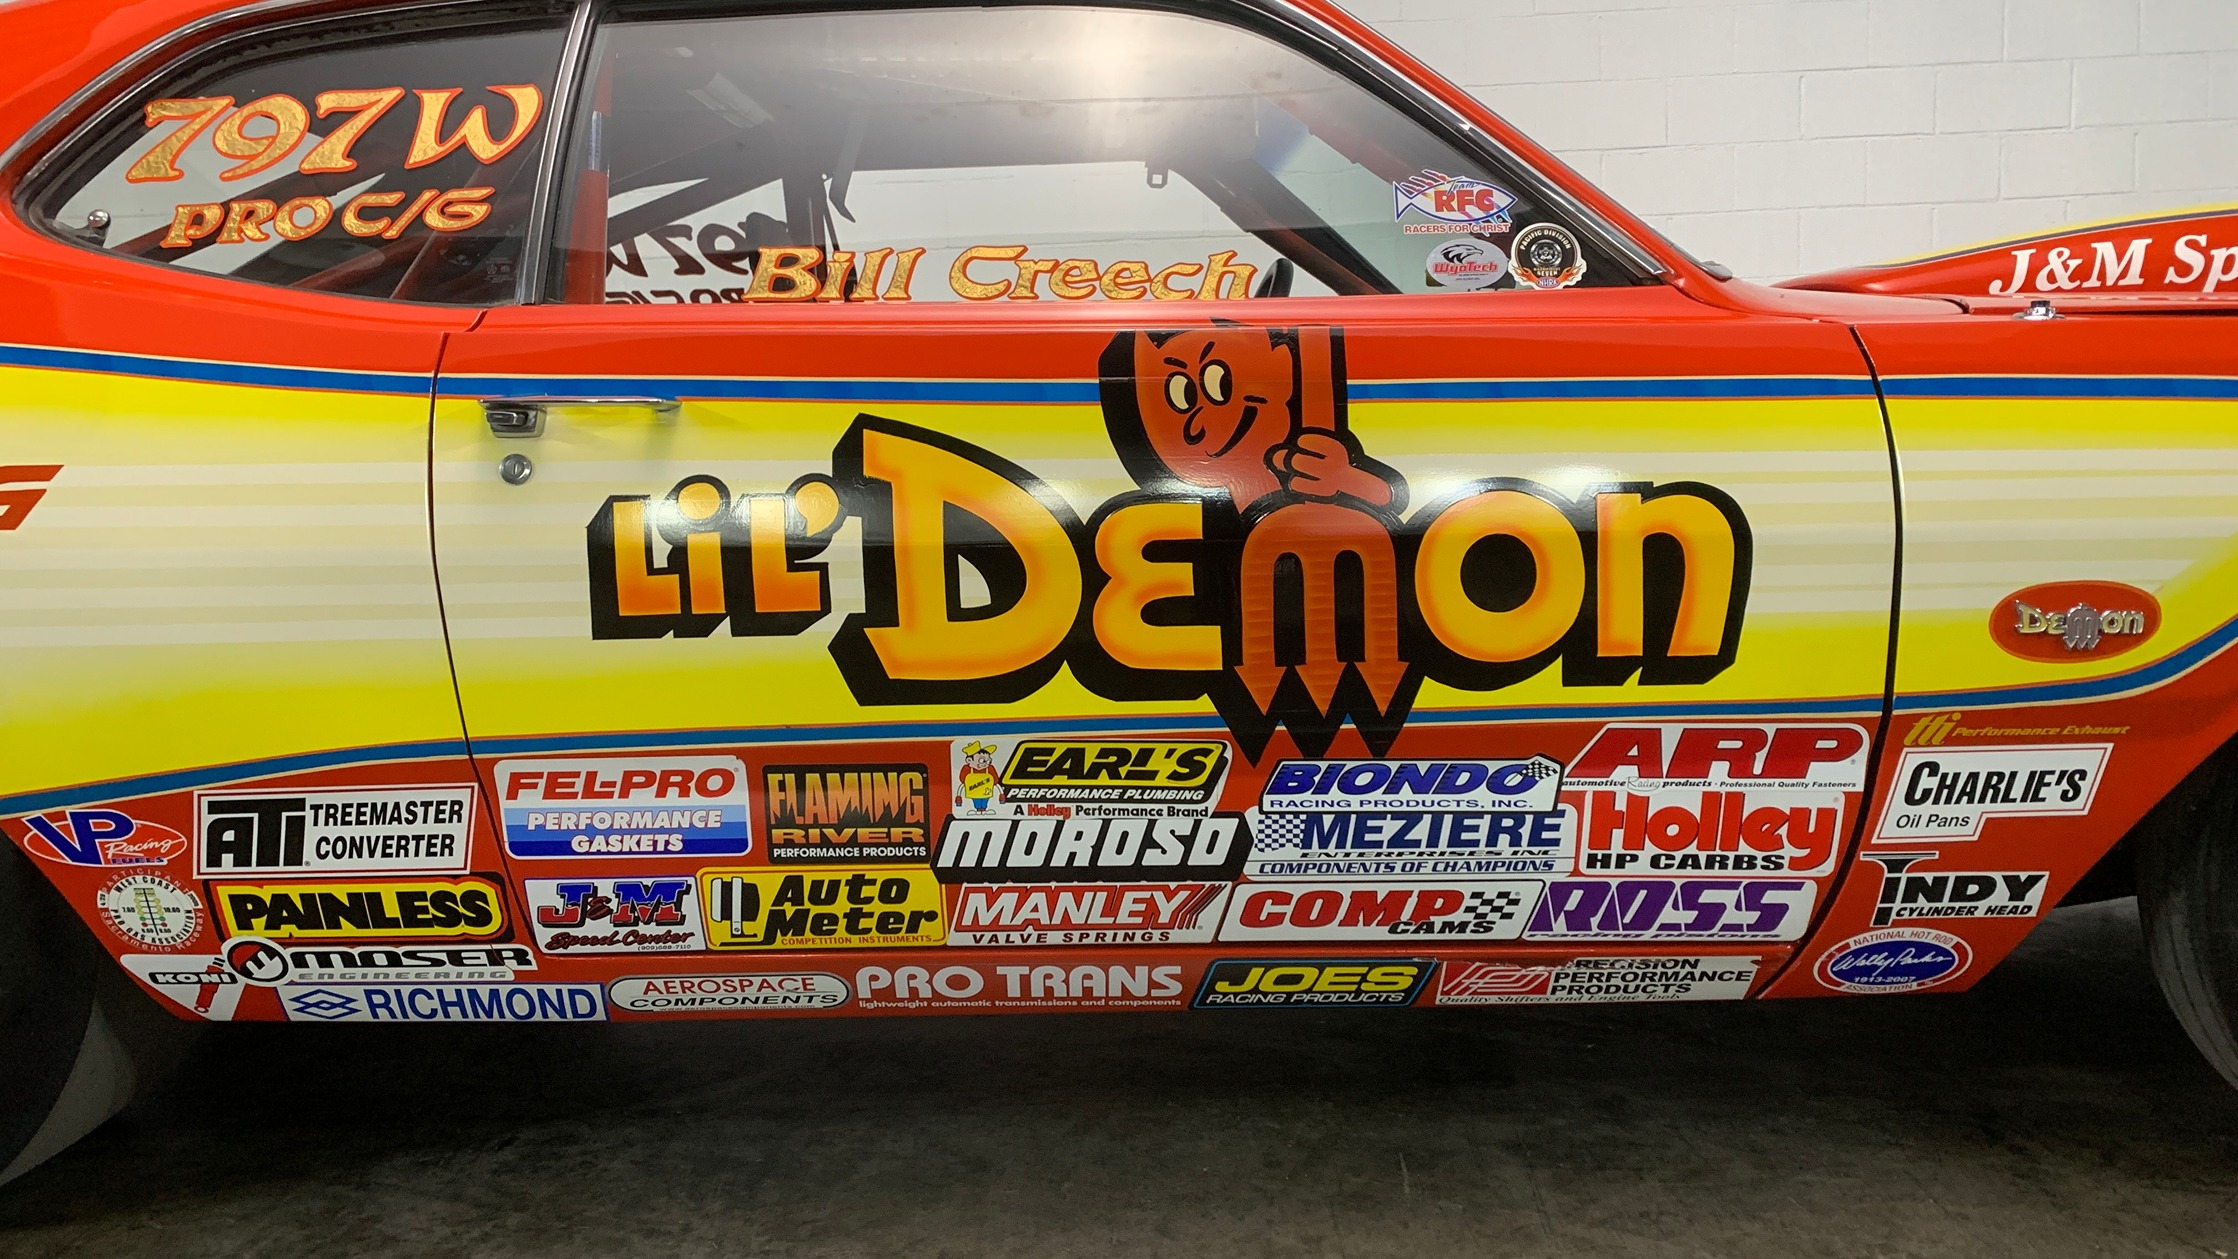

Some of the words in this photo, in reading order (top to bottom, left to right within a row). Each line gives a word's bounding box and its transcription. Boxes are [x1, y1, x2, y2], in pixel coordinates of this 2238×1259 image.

[1434, 189, 1495, 213] RFC
[160, 196, 333, 248] PRO
[341, 186, 495, 239] C/G
[1404, 225, 1446, 234] RACERS
[1447, 224, 1471, 233] FOR
[1472, 223, 1510, 232] CHRIST
[1520, 229, 1542, 250] PACIFIC
[1544, 229, 1571, 250] DIVISION
[741, 245, 927, 301] Bill
[948, 245, 1255, 301] Creech
[1434, 261, 1497, 275] WyoTech
[1989, 239, 2152, 296] J&M
[1903, 712, 1962, 746] tti
[1952, 726, 2060, 737] Performance
[2062, 725, 2131, 735] Exhaust
[1565, 727, 1863, 779] ARP
[1009, 747, 1215, 781] EARL'S
[1265, 763, 1542, 796] BIONDO
[1562, 779, 1626, 787] automotive
[1662, 779, 1712, 788] products
[1778, 781, 1809, 789] Quality
[767, 772, 927, 824] FLAMING
[1007, 787, 1121, 800] PERFORMANCE
[1123, 789, 1204, 800] PLUMBING
[309, 800, 464, 827] TREEMASTER
[1014, 805, 1024, 816] A
[1028, 804, 1071, 820] Holley
[1075, 806, 1165, 818] Performance
[1167, 806, 1209, 818] Brand
[1269, 799, 1352, 809] RACING
[1359, 799, 1484, 809] PRODUCTS,
[1489, 799, 1533, 809] INC.
[527, 809, 722, 831] PERFORMANCE
[1301, 810, 1567, 849] MEZIERE
[1896, 814, 1920, 829] Oil
[1925, 813, 1970, 828] Pans
[23, 809, 136, 866] VP
[206, 798, 306, 868] ATI
[772, 827, 925, 844] RIVER
[1588, 791, 1837, 871] Holley
[105, 838, 172, 858] Racing
[314, 833, 455, 860] CONVERTER
[571, 834, 684, 853] GASKETS
[773, 847, 860, 858] PERFORMANCE
[862, 846, 926, 857] PRODUCTS
[936, 818, 1239, 868] MOROSO
[110, 857, 166, 865] FUELS
[1301, 850, 1505, 858] ENTERPRISES
[1586, 854, 1639, 870] HP
[1650, 853, 1785, 870] CARBS
[1258, 860, 1396, 874] COMPONENTS
[1400, 860, 1429, 873] OF
[1431, 859, 1556, 872] CHAMPIONS
[114, 877, 137, 893] WEST
[142, 876, 177, 893] COAST
[772, 874, 910, 907] Auto
[227, 889, 494, 931] PAINLESS
[538, 880, 691, 927] J&M
[962, 890, 1192, 927] MANLEY
[1239, 890, 1465, 928] COMP
[1527, 881, 1806, 932] ROSS
[1896, 906, 1978, 917] CYLINDER
[1984, 905, 2033, 916] HEAD
[102, 912, 171, 952] Sacramento
[176, 913, 204, 950] Raceway
[126, 927, 145, 941] GAS
[151, 910, 194, 944] ASSOCIATION
[764, 907, 939, 941] Meter
[1388, 920, 1499, 935] CAMS
[544, 930, 622, 950] Speed
[622, 929, 695, 946] Center
[781, 937, 852, 946] COMPETITION
[858, 935, 932, 943] INSTRUMENTS
[972, 933, 1048, 944] VALVE
[1062, 931, 1171, 943] SPRINGS
[1853, 930, 1907, 946] NATIONAL
[1911, 930, 1932, 940] HOT
[1932, 933, 1953, 945] ROD
[292, 949, 533, 969] MOSER
[155, 972, 229, 984] KONI
[298, 970, 507, 982] ENGINEERING
[856, 966, 984, 998] PRO
[996, 966, 1183, 997] TRANS
[1215, 966, 1419, 992] JOES
[1554, 970, 1753, 983] PERFORMANCE
[1854, 975, 1916, 983] 1913-2007
[643, 978, 816, 995] AEROSPACE
[1551, 983, 1691, 996] PRODUCTS
[1844, 983, 1913, 992] ASSOCIATION
[363, 988, 598, 1020] RICHMOND
[630, 994, 838, 1008] COMPONENTS
[859, 1000, 928, 1009] lightweight
[931, 1000, 992, 1008] automatic
[995, 999, 1078, 1007] transmissions
[1081, 999, 1105, 1007] and
[1108, 999, 1182, 1007] components
[1206, 993, 1286, 1004] RACING
[1290, 992, 1405, 1003] PRODUCTS
[1439, 995, 1489, 1004] Quality
[1587, 993, 1643, 1002] Engine
